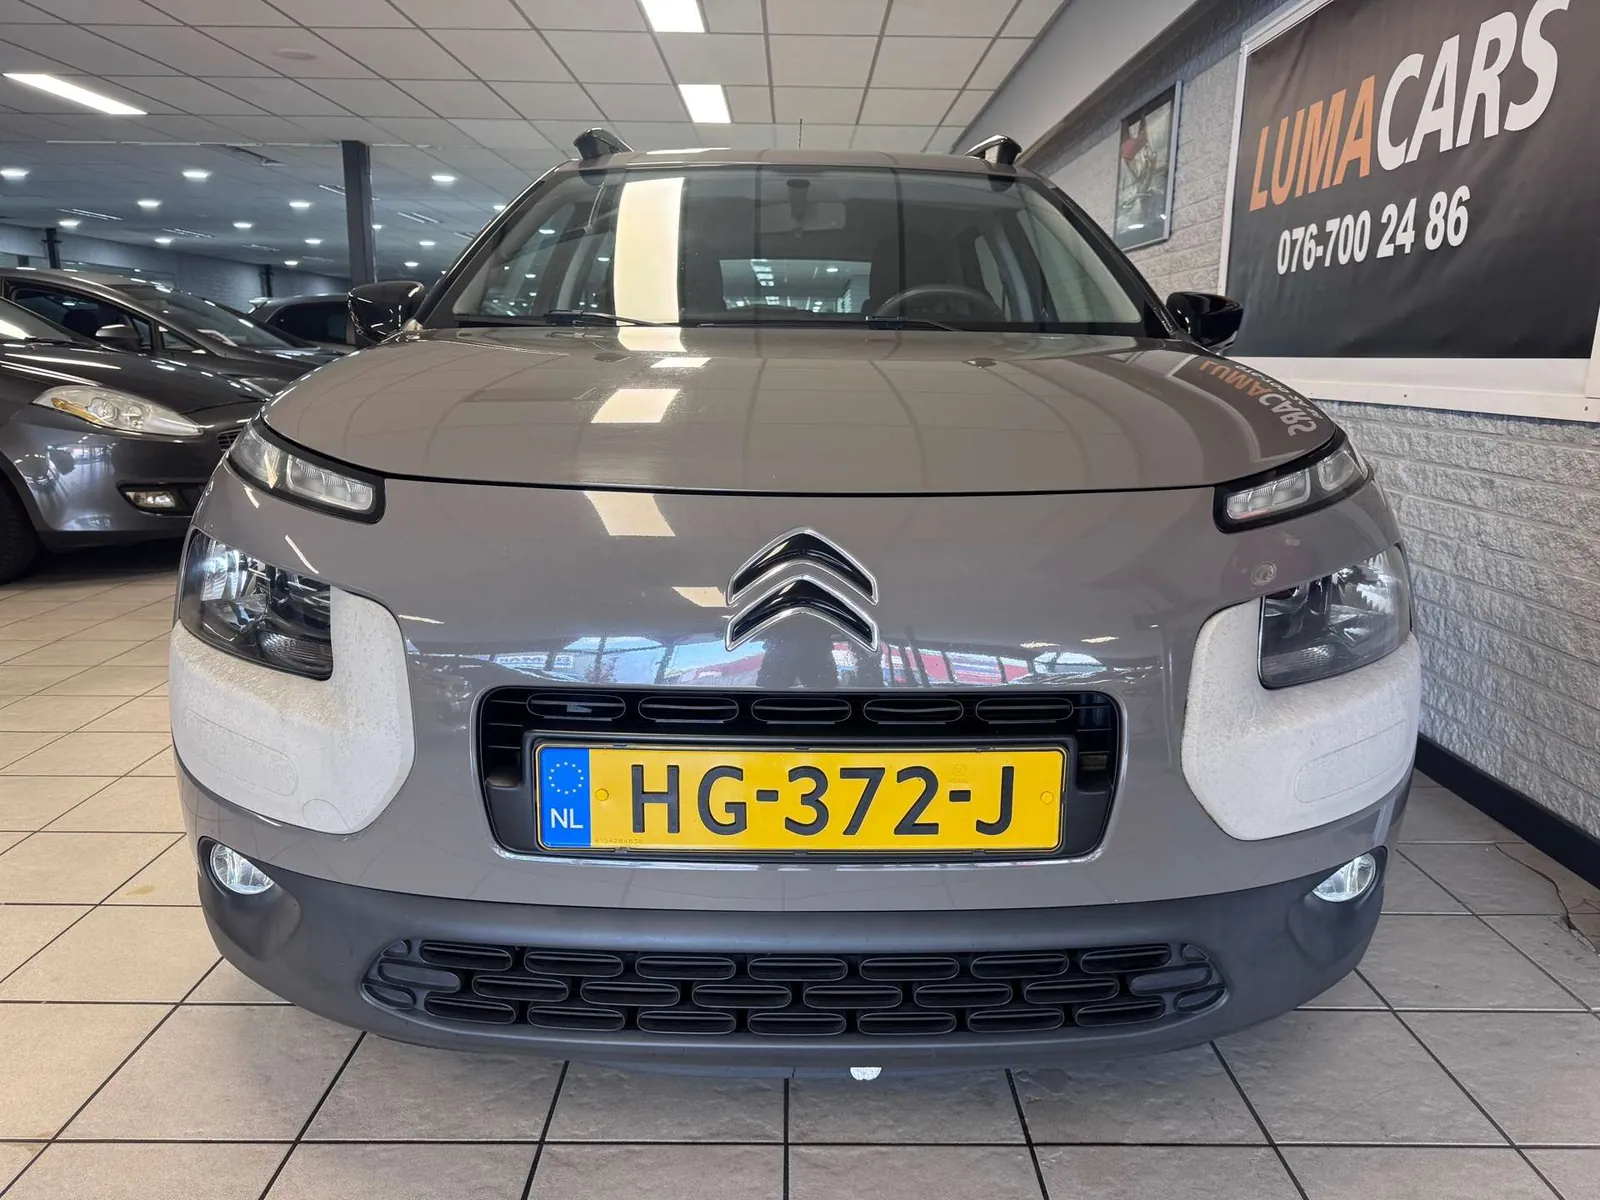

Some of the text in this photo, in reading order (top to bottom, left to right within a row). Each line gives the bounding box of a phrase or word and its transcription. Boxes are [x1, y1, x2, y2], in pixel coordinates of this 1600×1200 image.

[1277, 185, 1470, 275] 076-700 24 86
[551, 808, 584, 828] NL
[631, 764, 1015, 836] HG-372-J
